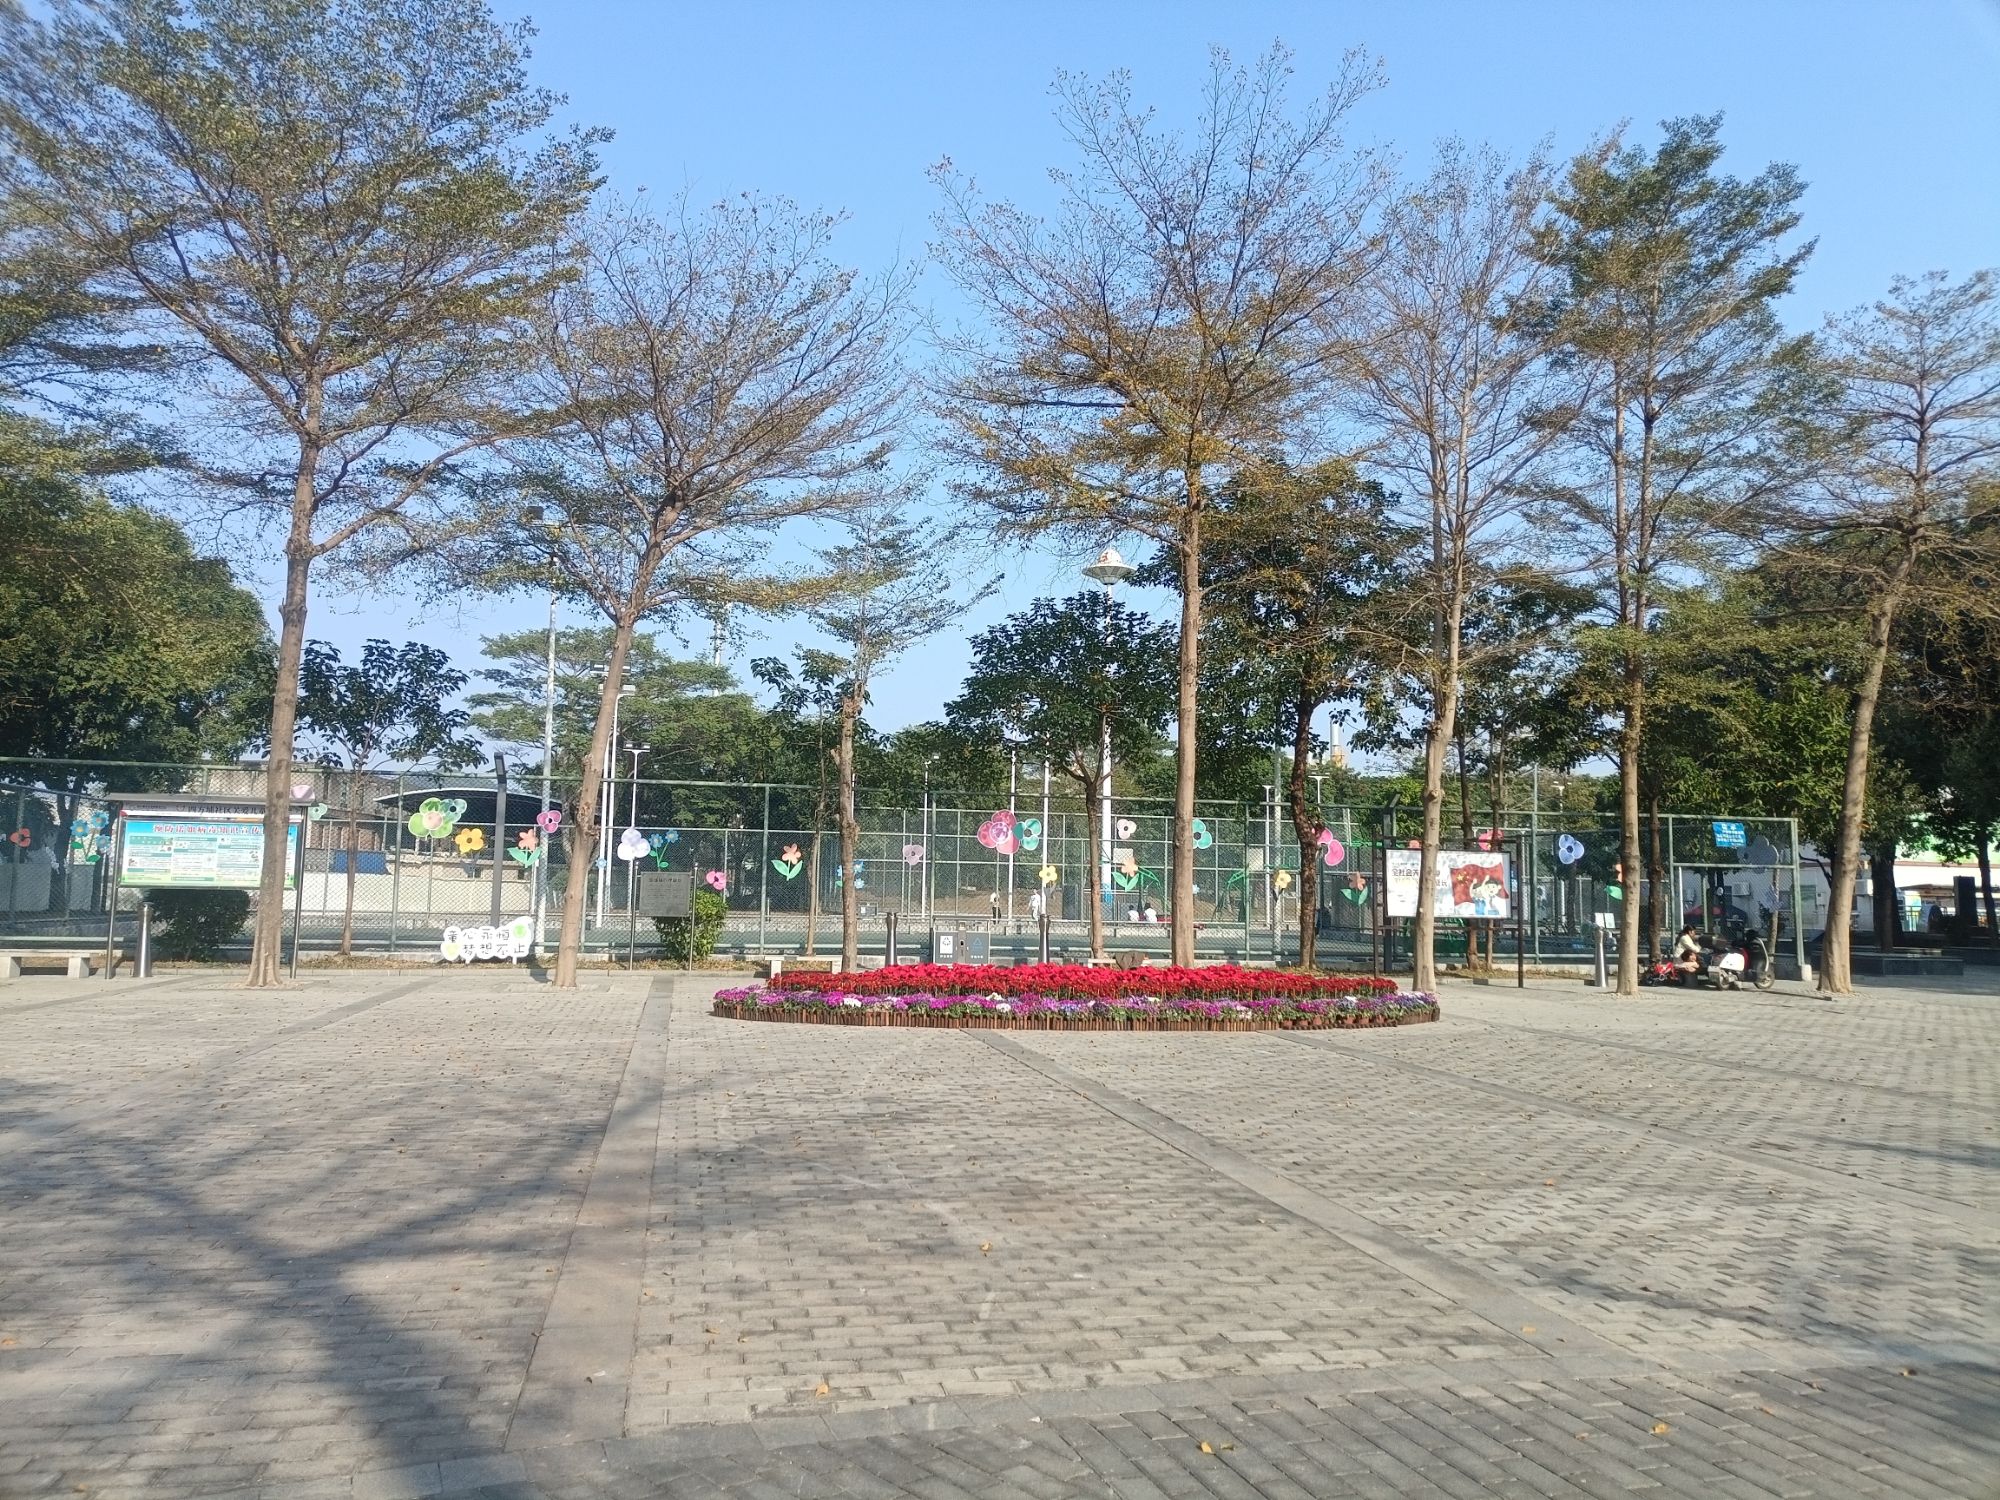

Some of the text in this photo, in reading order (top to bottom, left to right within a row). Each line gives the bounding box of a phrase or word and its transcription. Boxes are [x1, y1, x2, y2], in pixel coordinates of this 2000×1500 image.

[447, 929, 509, 943] 童心永恒
[463, 943, 525, 956] 梦想不止
